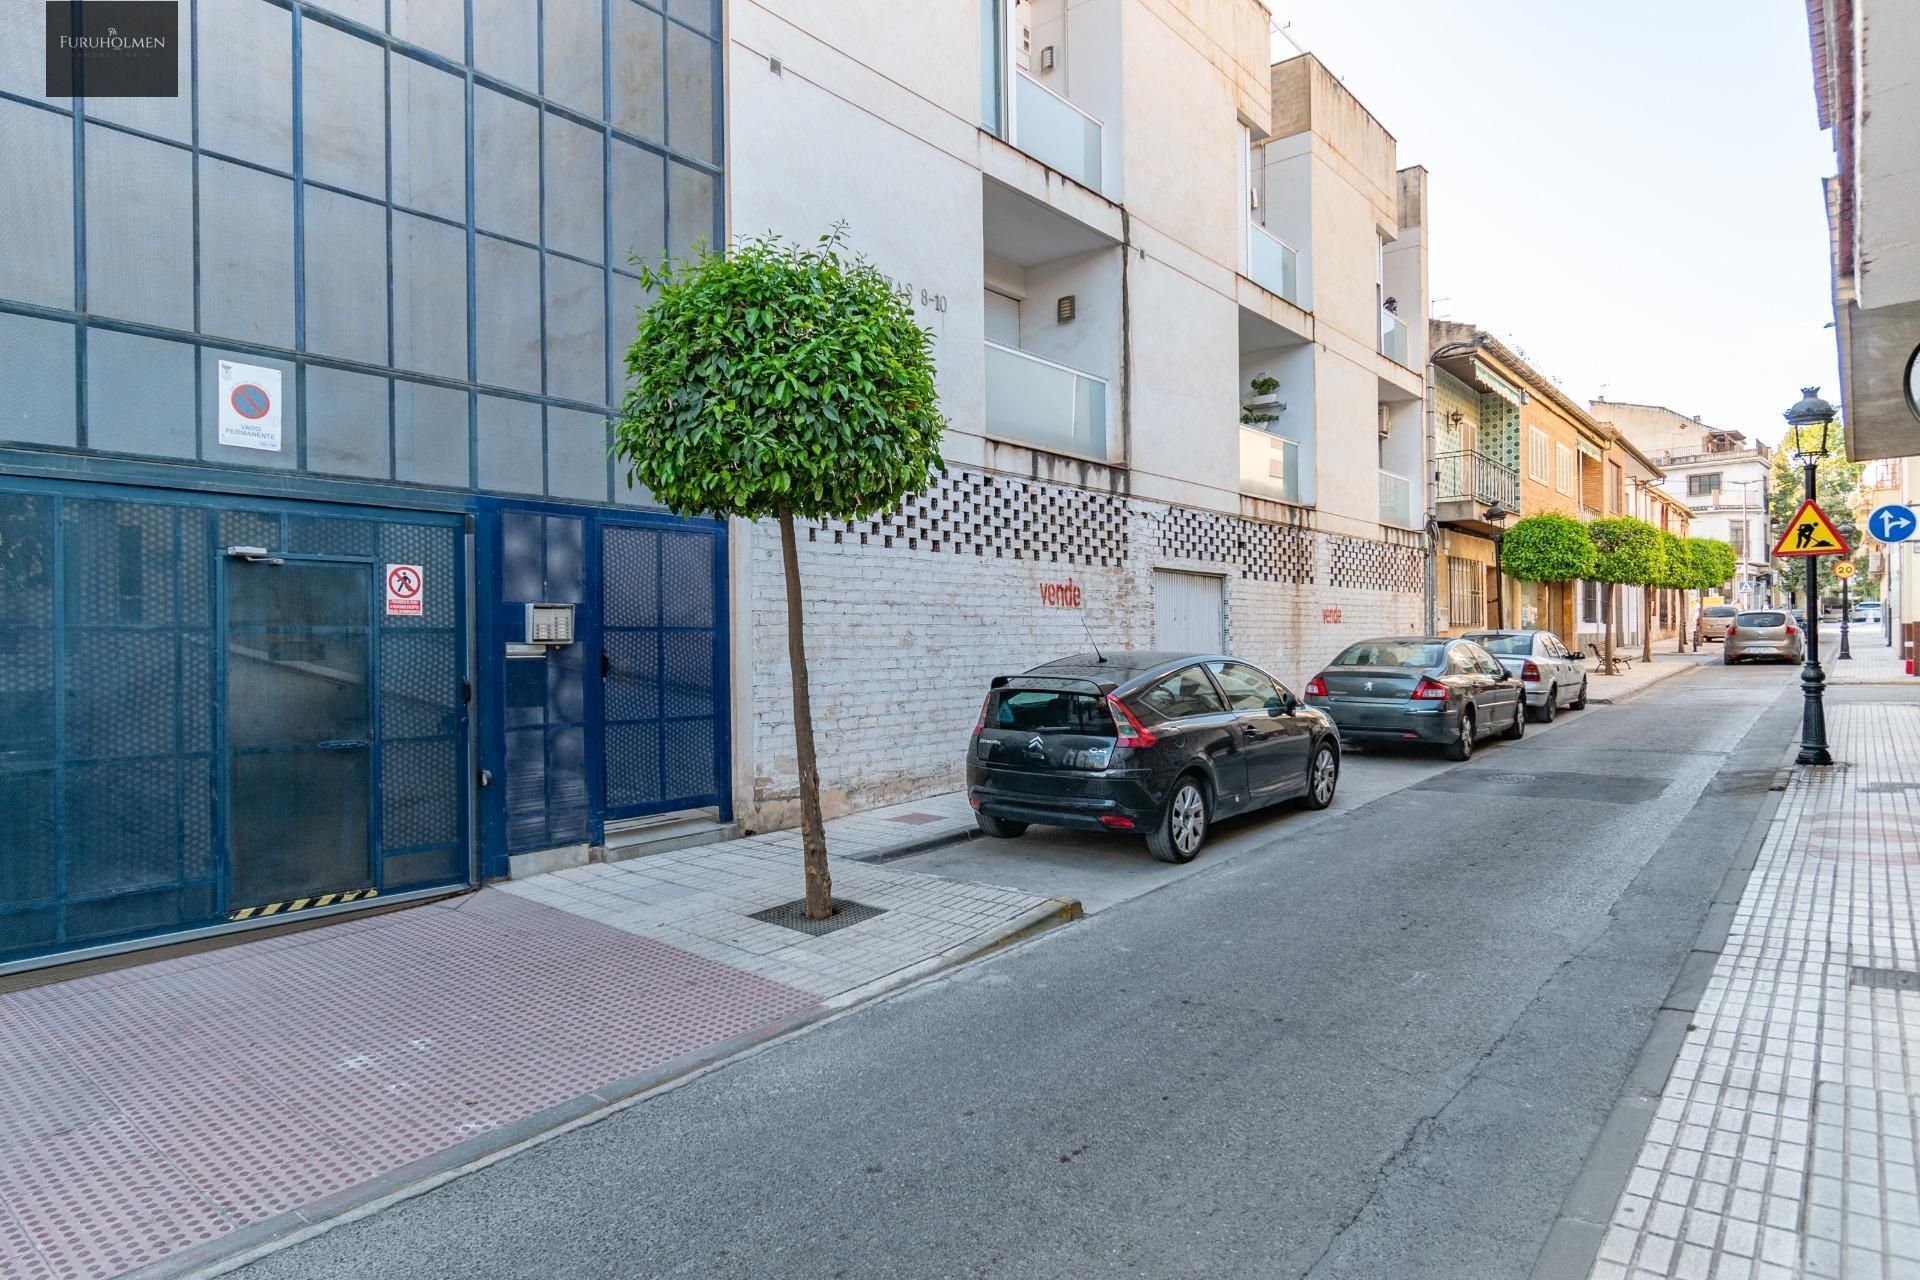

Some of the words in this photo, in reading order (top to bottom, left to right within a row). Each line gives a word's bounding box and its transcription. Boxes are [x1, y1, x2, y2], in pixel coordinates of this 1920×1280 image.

[920, 288, 947, 313] 8-10
[225, 427, 277, 440] PERMANENTE
[240, 423, 262, 432] VADO
[1838, 566, 1852, 574] 20
[1039, 577, 1081, 607] vende
